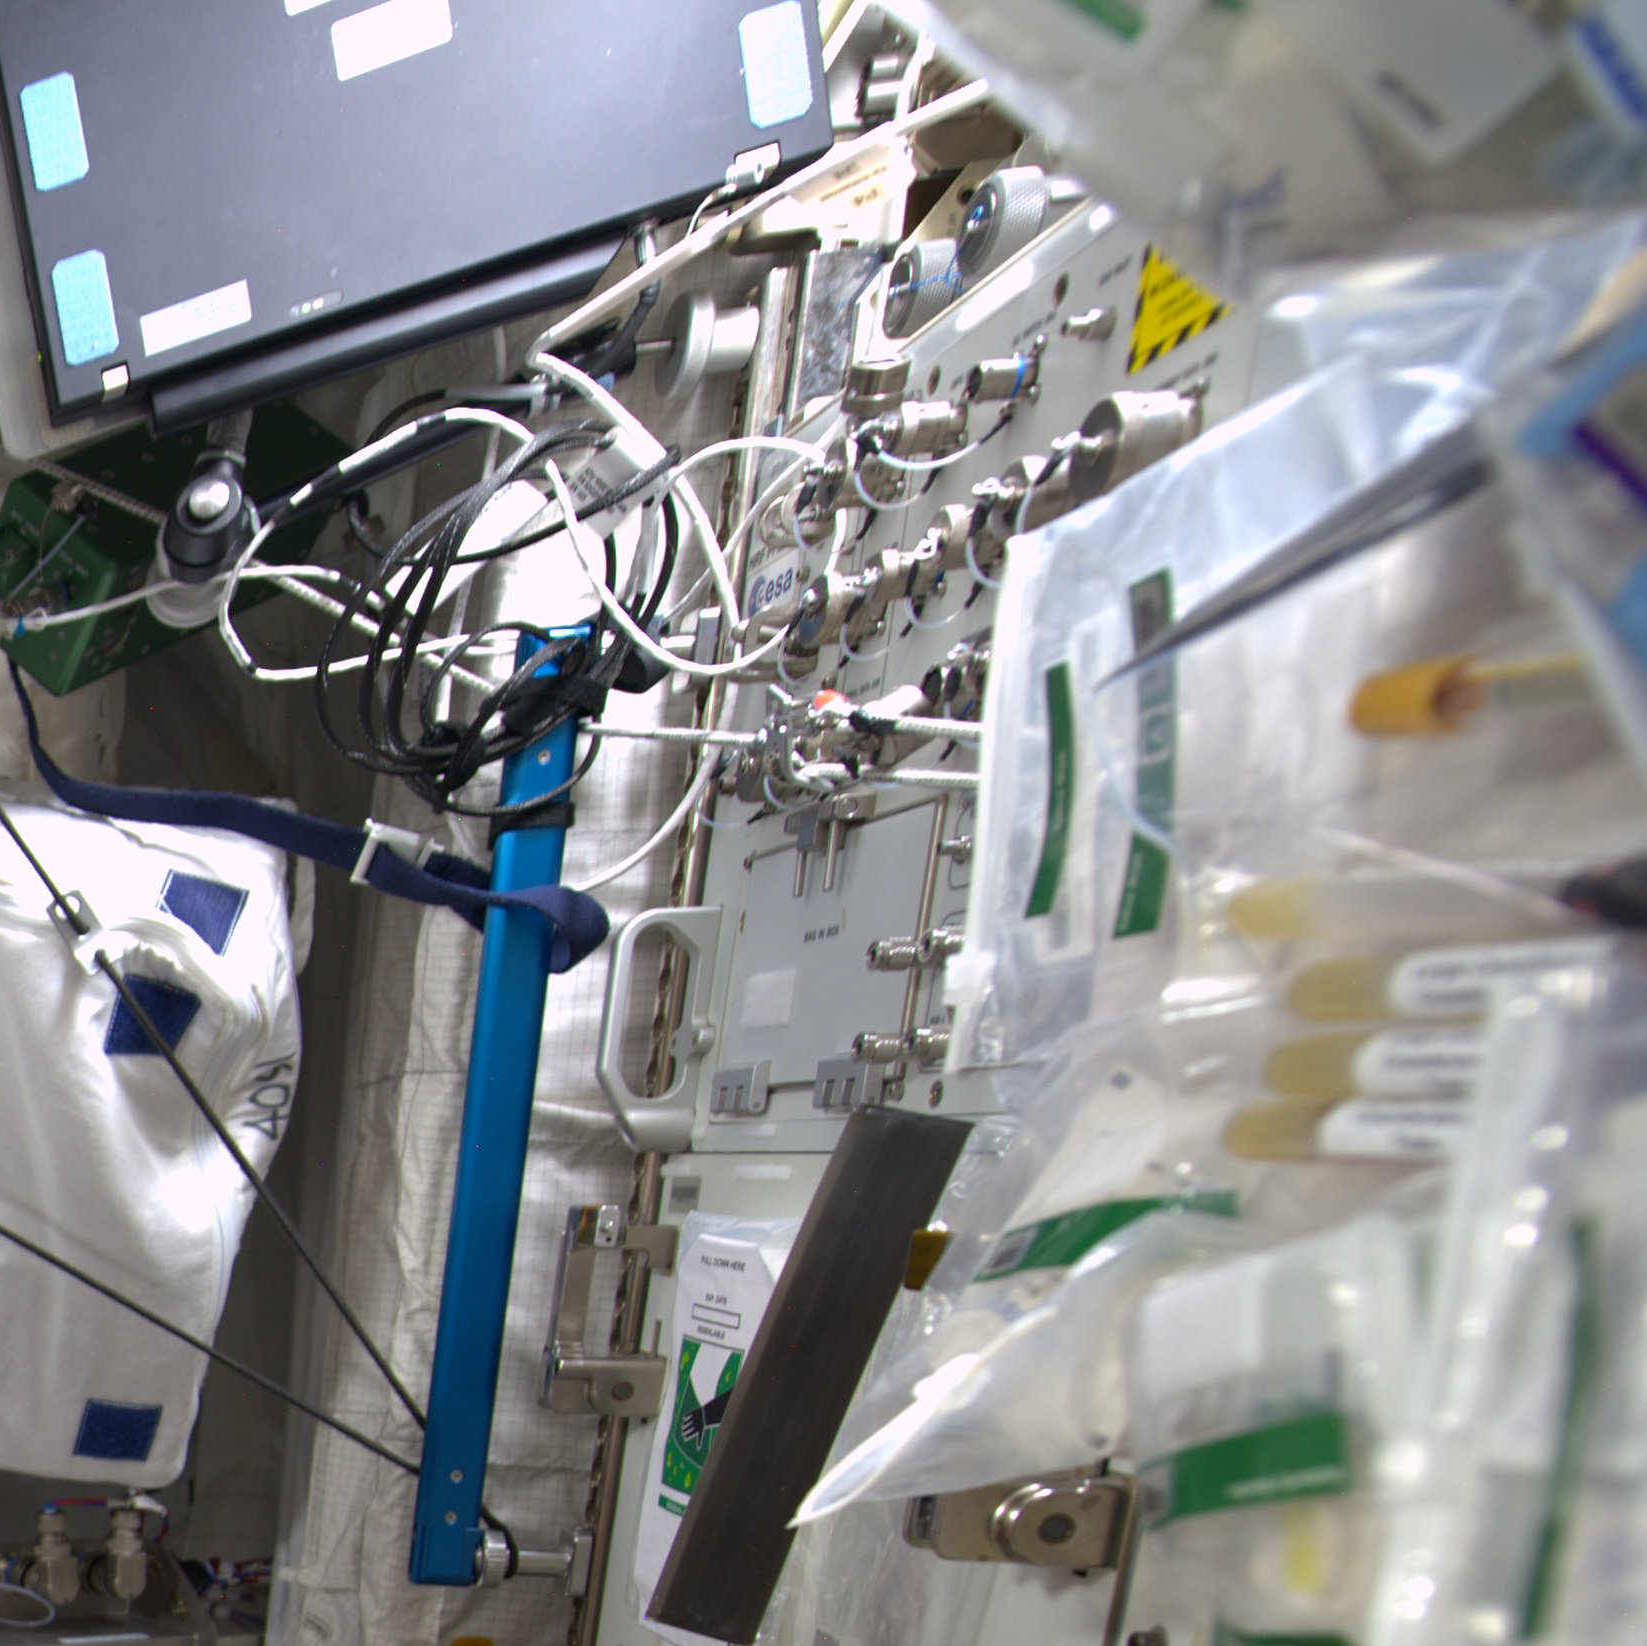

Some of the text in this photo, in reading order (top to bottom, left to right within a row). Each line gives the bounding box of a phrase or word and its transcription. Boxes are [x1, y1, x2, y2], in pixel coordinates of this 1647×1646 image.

[765, 568, 793, 603] esa
[244, 1052, 295, 1142] 4091
[701, 1254, 746, 1272] PULL DOWN HERE
